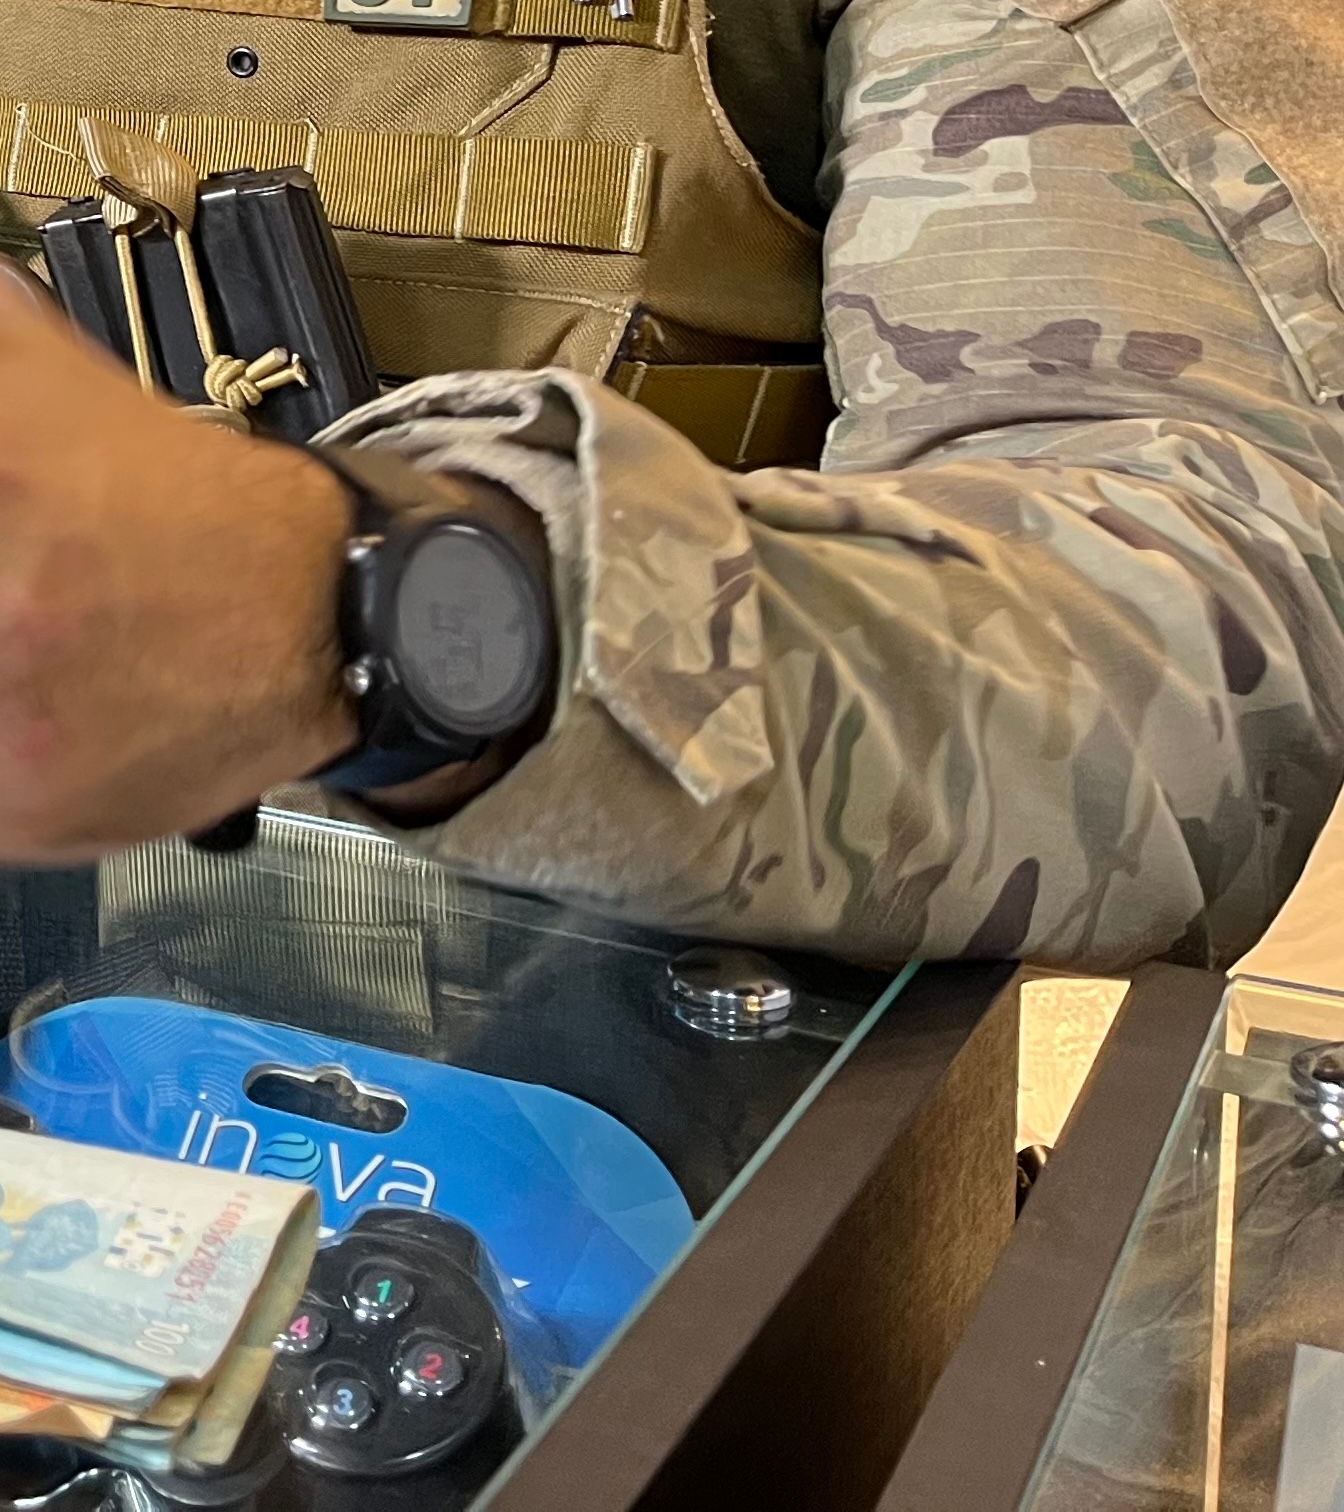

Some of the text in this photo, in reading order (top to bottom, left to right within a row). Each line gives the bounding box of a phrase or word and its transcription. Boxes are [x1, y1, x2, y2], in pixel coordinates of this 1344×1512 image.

[376, 1279, 392, 1305] 1
[132, 1317, 193, 1360] 100
[289, 1314, 311, 1341] 4
[418, 1352, 443, 1380] 2
[331, 1388, 355, 1416] 3
